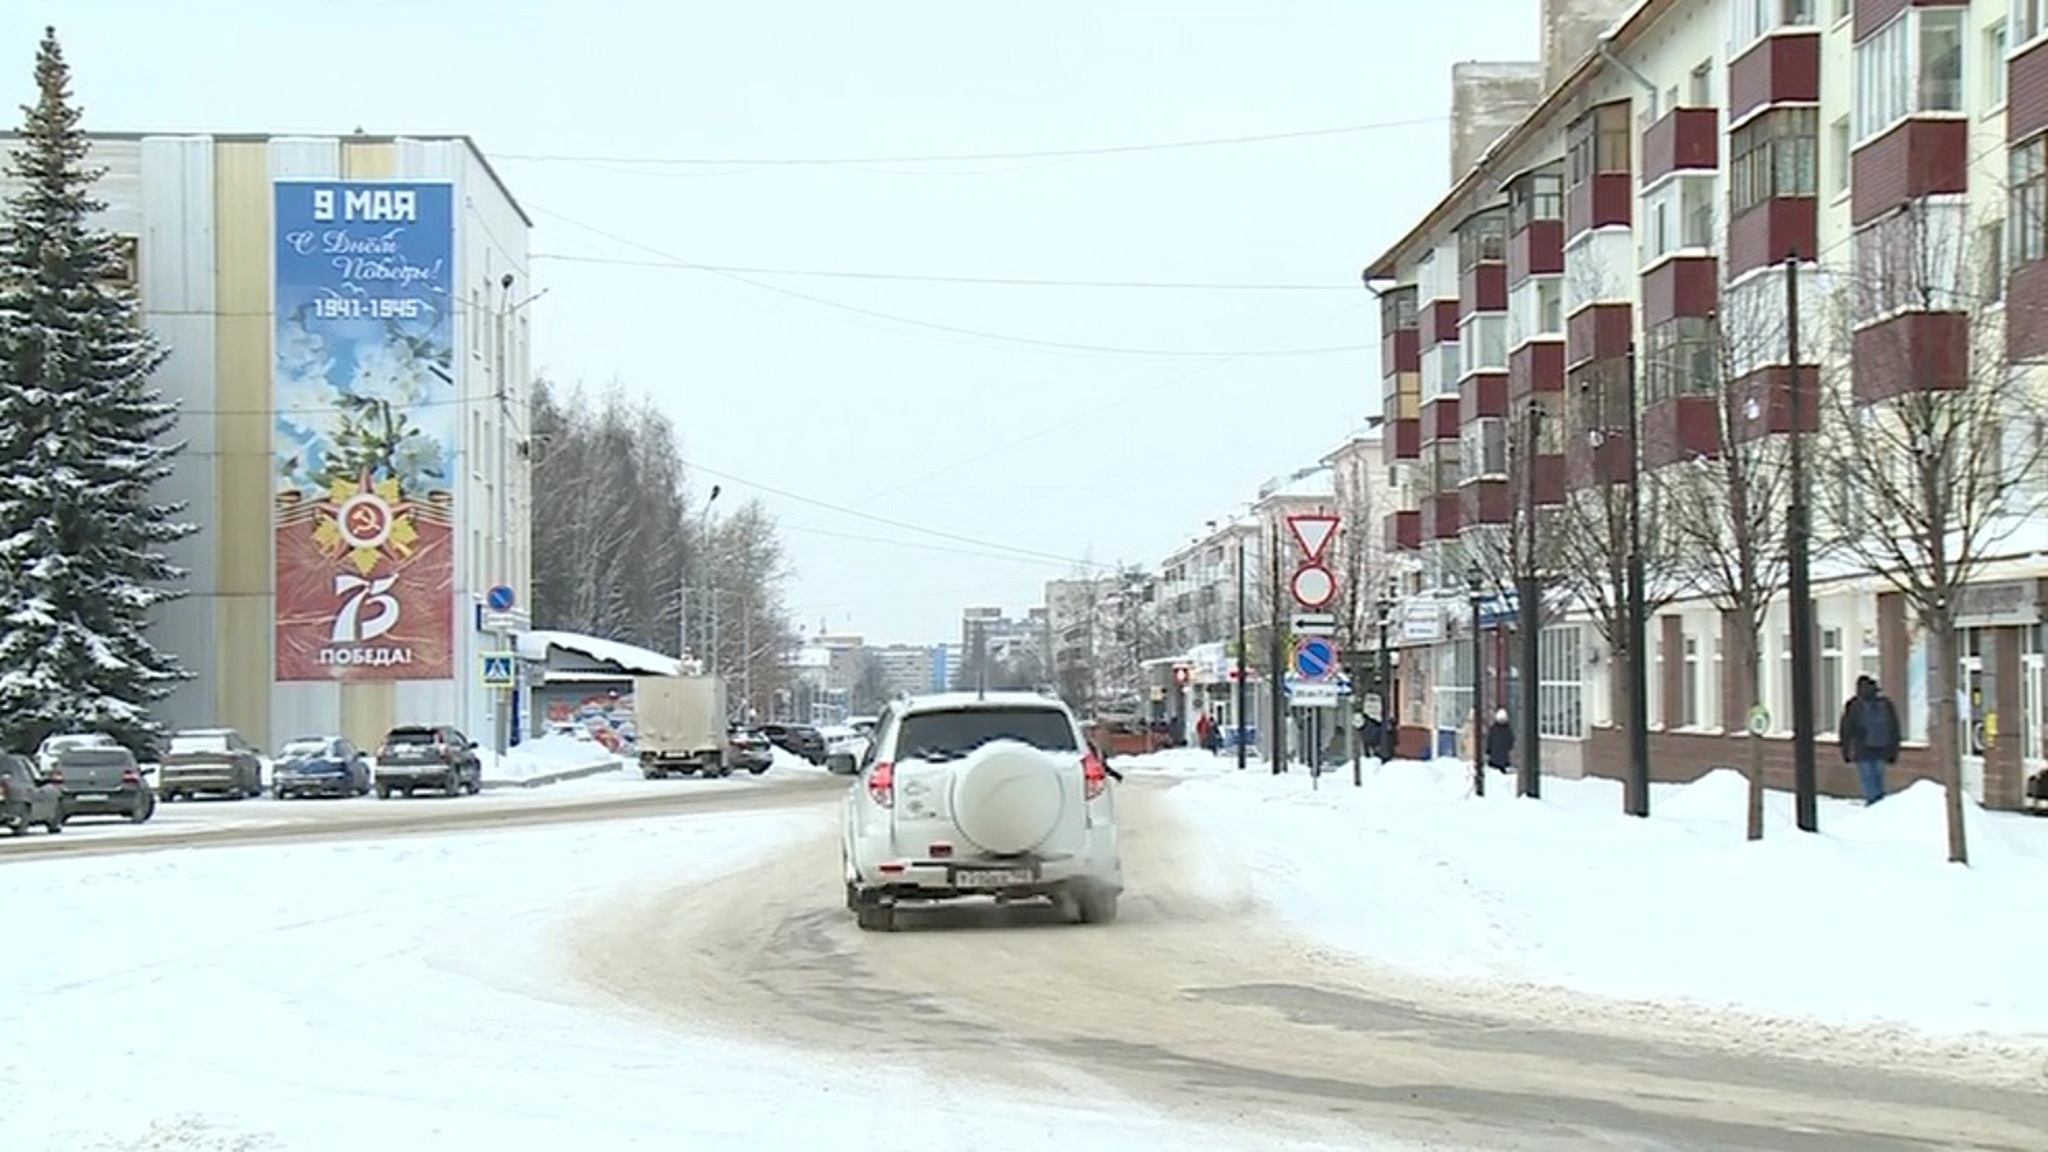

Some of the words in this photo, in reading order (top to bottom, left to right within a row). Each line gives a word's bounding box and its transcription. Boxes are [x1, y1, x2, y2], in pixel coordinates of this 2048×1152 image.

[314, 190, 334, 220] 9
[345, 190, 416, 220] МАЯ
[323, 230, 397, 254] Днём
[332, 255, 443, 287] Победы!
[314, 299, 418, 317] 1941-1945
[332, 573, 399, 642] 75
[320, 648, 412, 667] ПОБЕДА!
